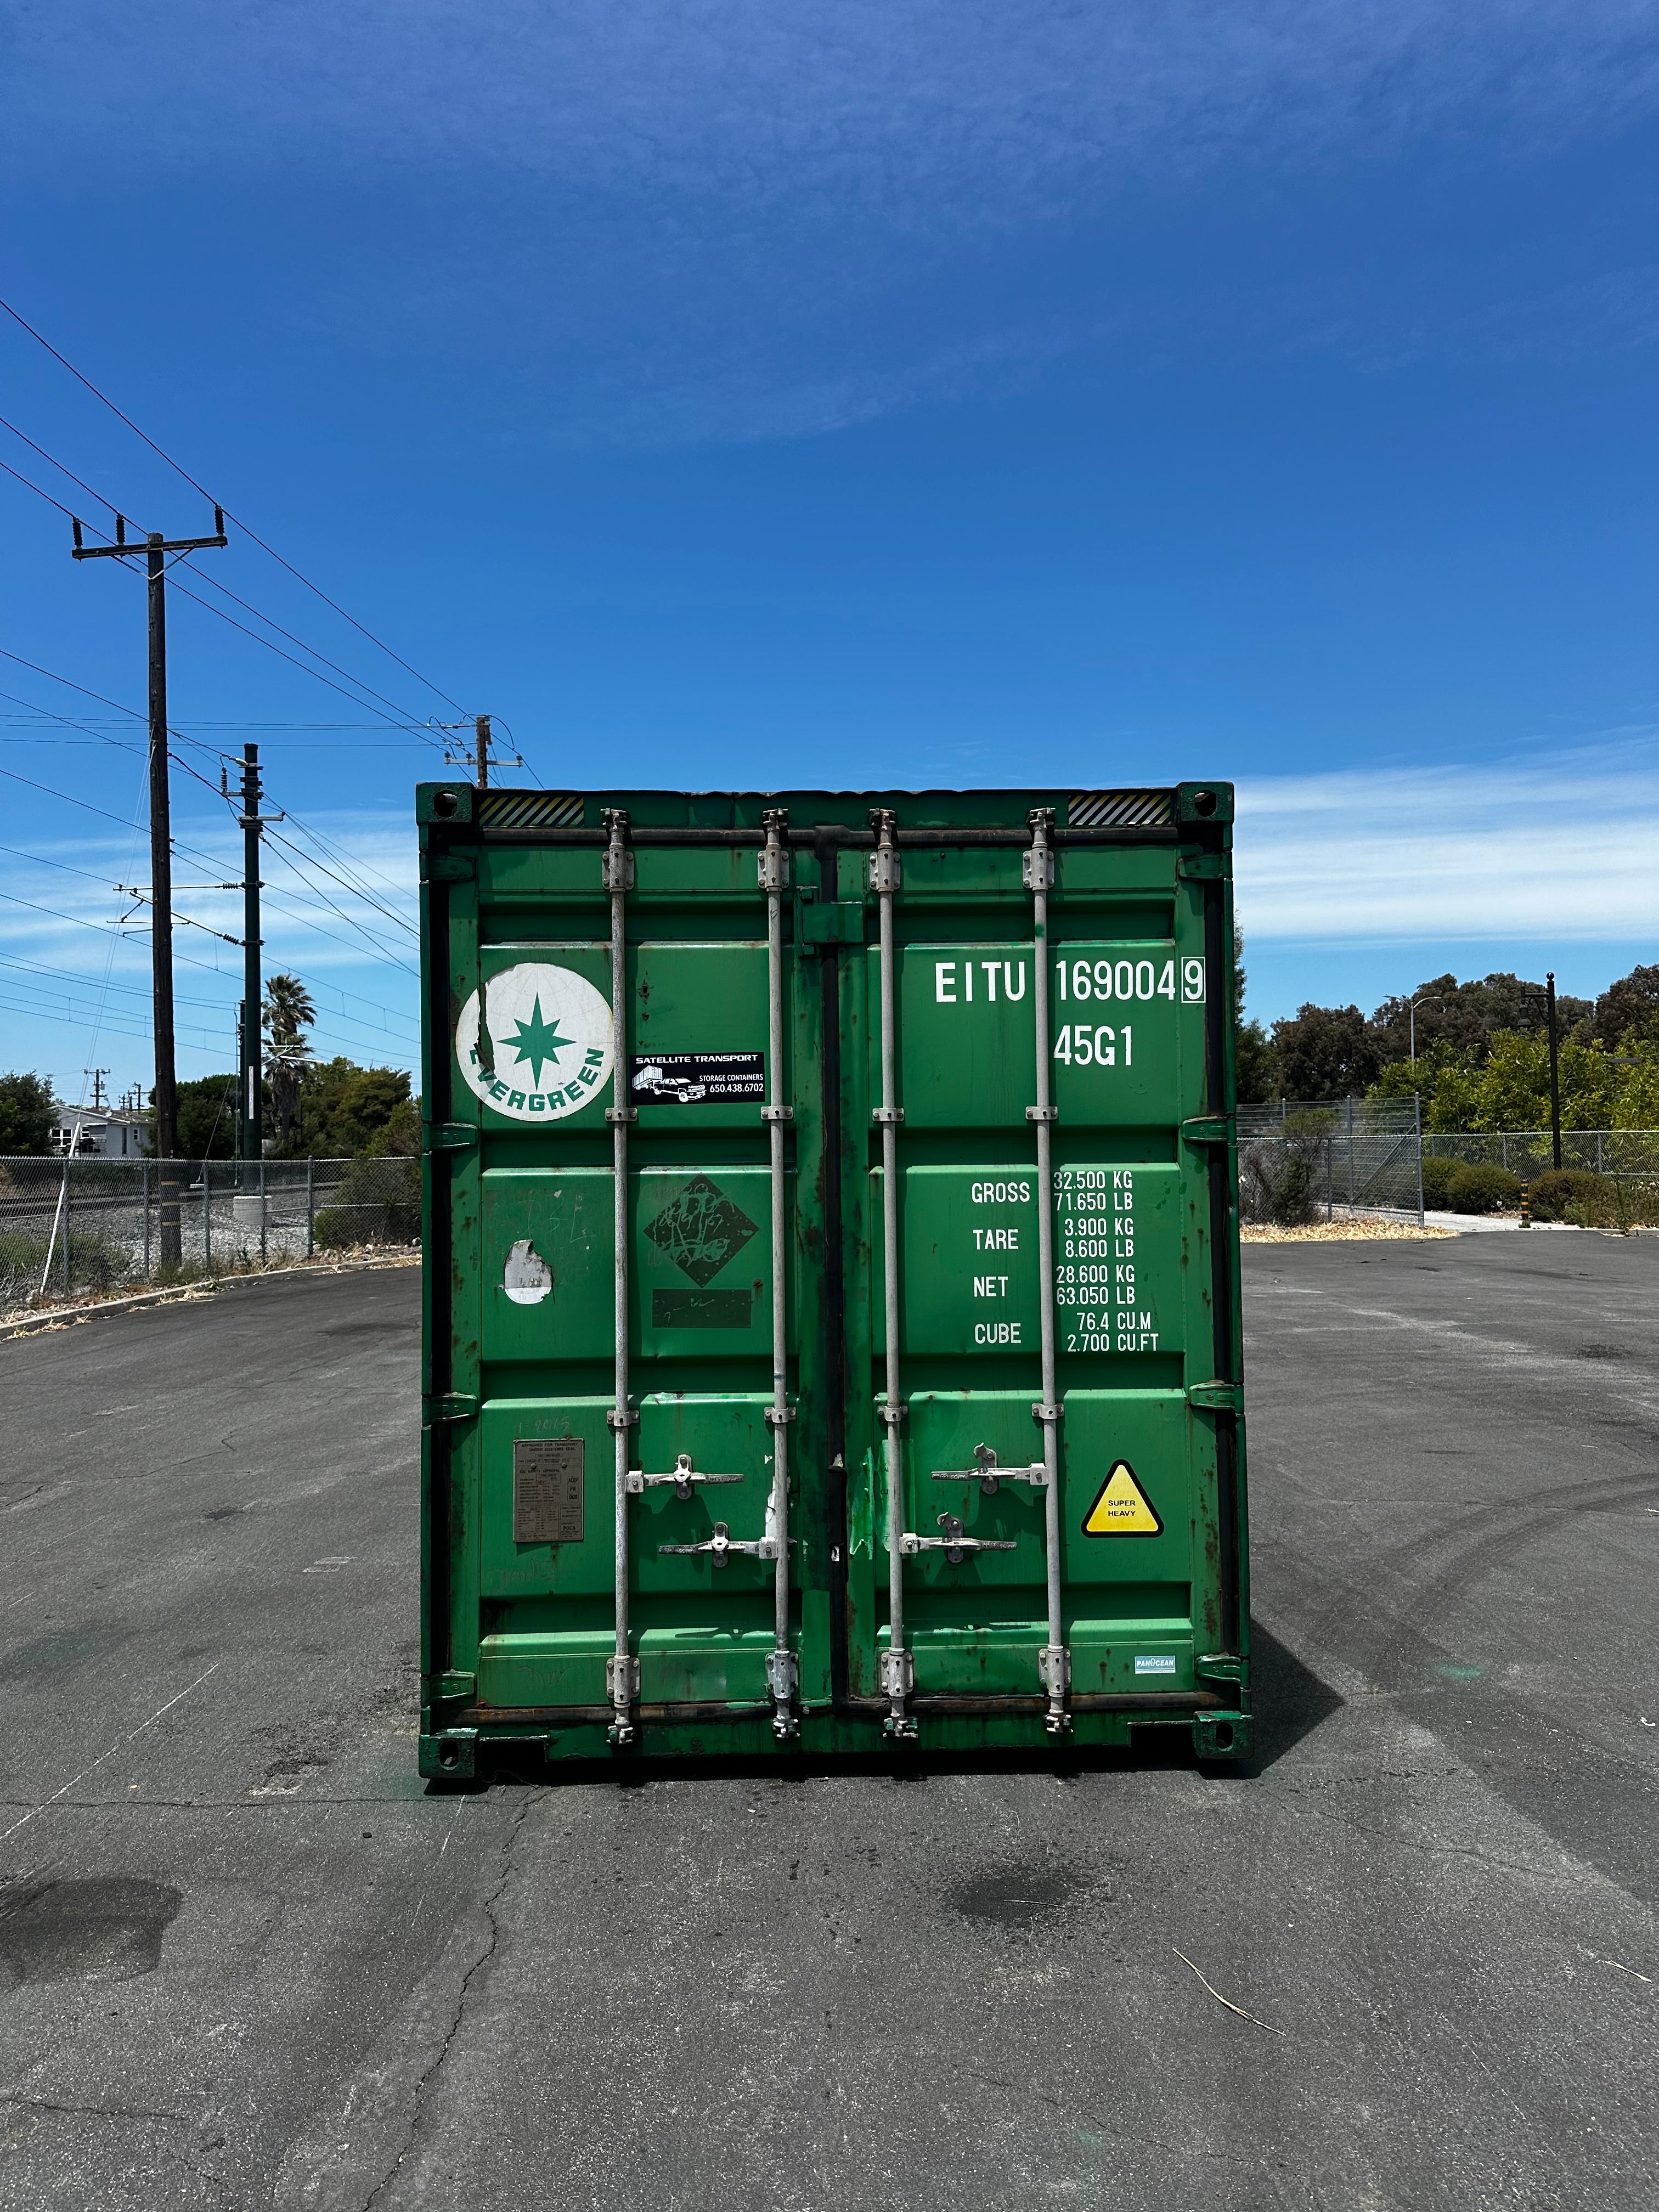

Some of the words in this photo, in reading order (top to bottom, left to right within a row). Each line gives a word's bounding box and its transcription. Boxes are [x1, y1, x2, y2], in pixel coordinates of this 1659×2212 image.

[935, 961, 1025, 1002] EITU
[1054, 1025, 1132, 1066] 45G1
[636, 1056, 691, 1064] SATELLITE
[694, 1054, 758, 1063] TRANSPORT
[709, 1084, 764, 1093] 650.438.6702
[1113, 1170, 1132, 1189] KG
[972, 1182, 1030, 1203] GROSS
[1114, 1192, 1133, 1210] LB
[1115, 1217, 1133, 1235] KG
[973, 1229, 1019, 1250] TARE
[1115, 1239, 1134, 1257] LB
[1116, 1265, 1135, 1283] KG
[974, 1276, 1008, 1297] NET
[1116, 1286, 1135, 1305] LB
[1076, 1312, 1109, 1330] 76.4
[1117, 1312, 1151, 1330] CU.M
[975, 1323, 1021, 1344] CUBE
[1118, 1333, 1159, 1352] CU.FT
